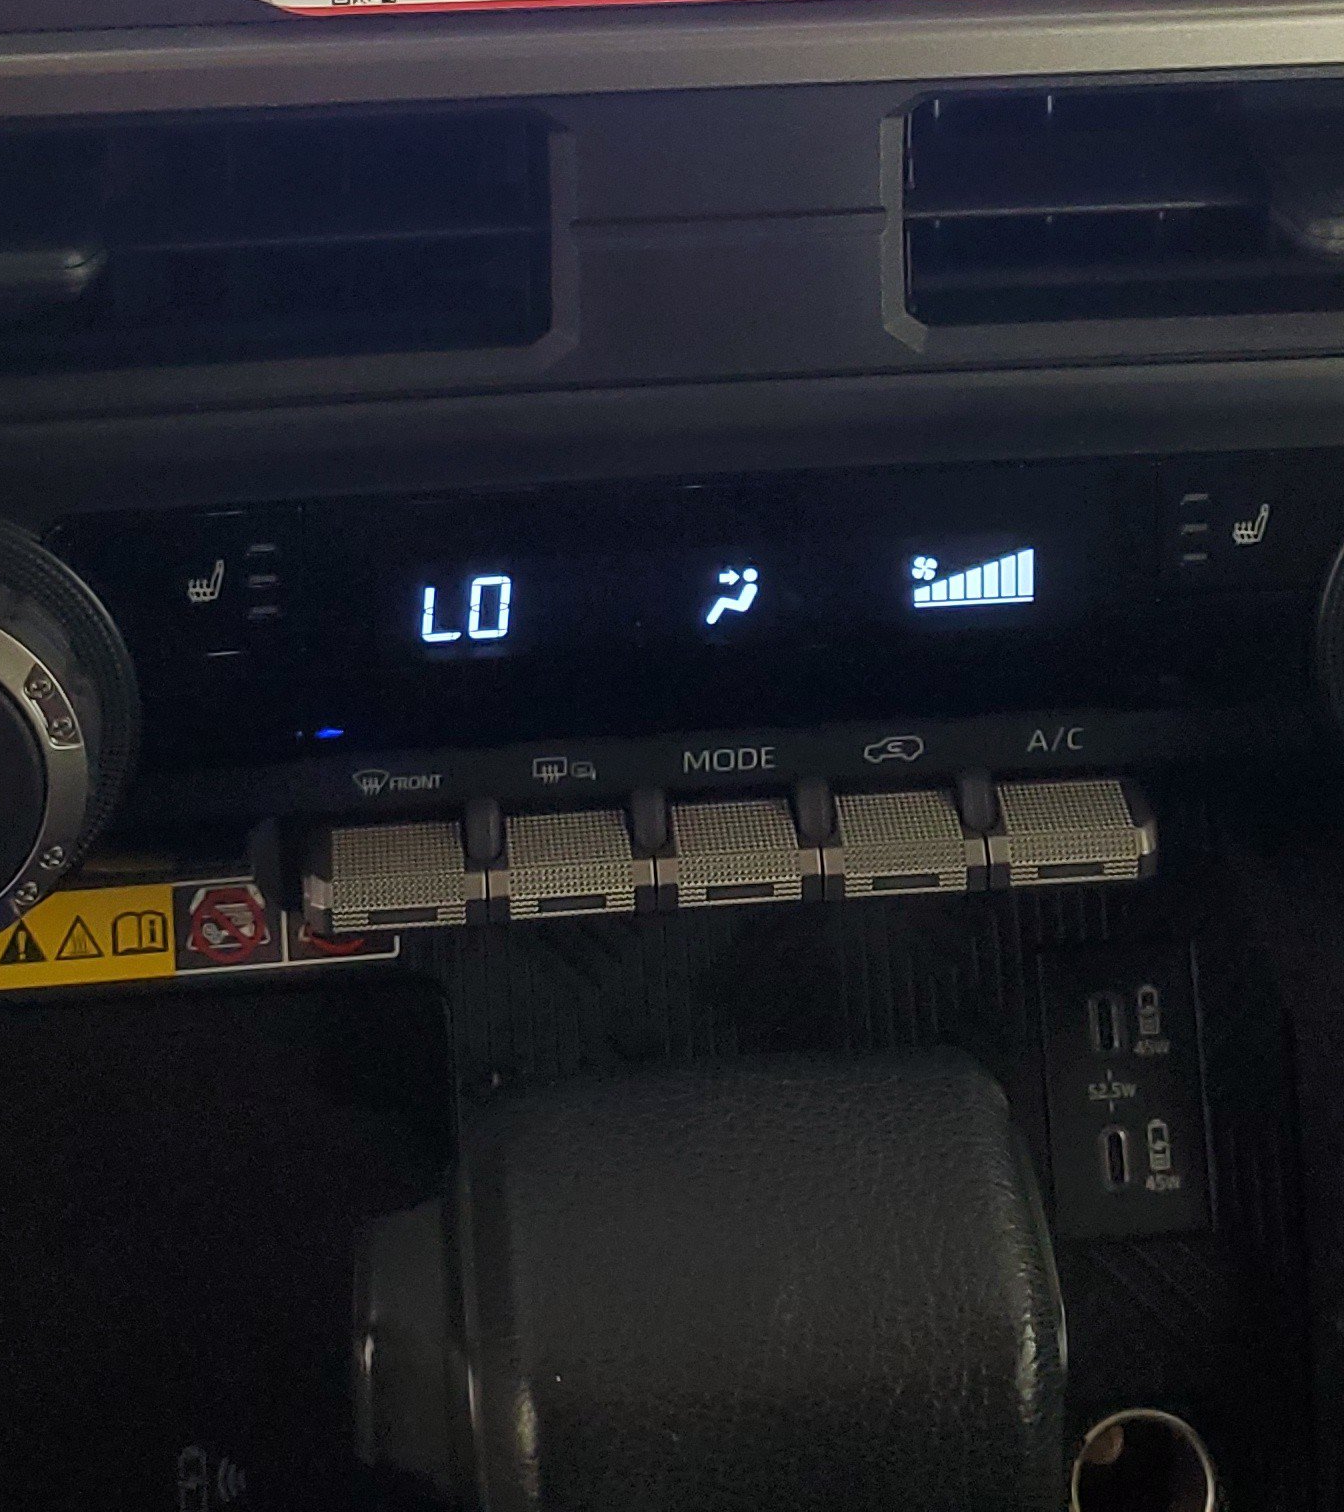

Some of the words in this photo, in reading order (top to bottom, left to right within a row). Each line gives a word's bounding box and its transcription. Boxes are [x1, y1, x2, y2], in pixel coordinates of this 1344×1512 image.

[1026, 726, 1086, 755] A/C
[682, 745, 777, 775] MODE
[389, 773, 443, 791] FRONT
